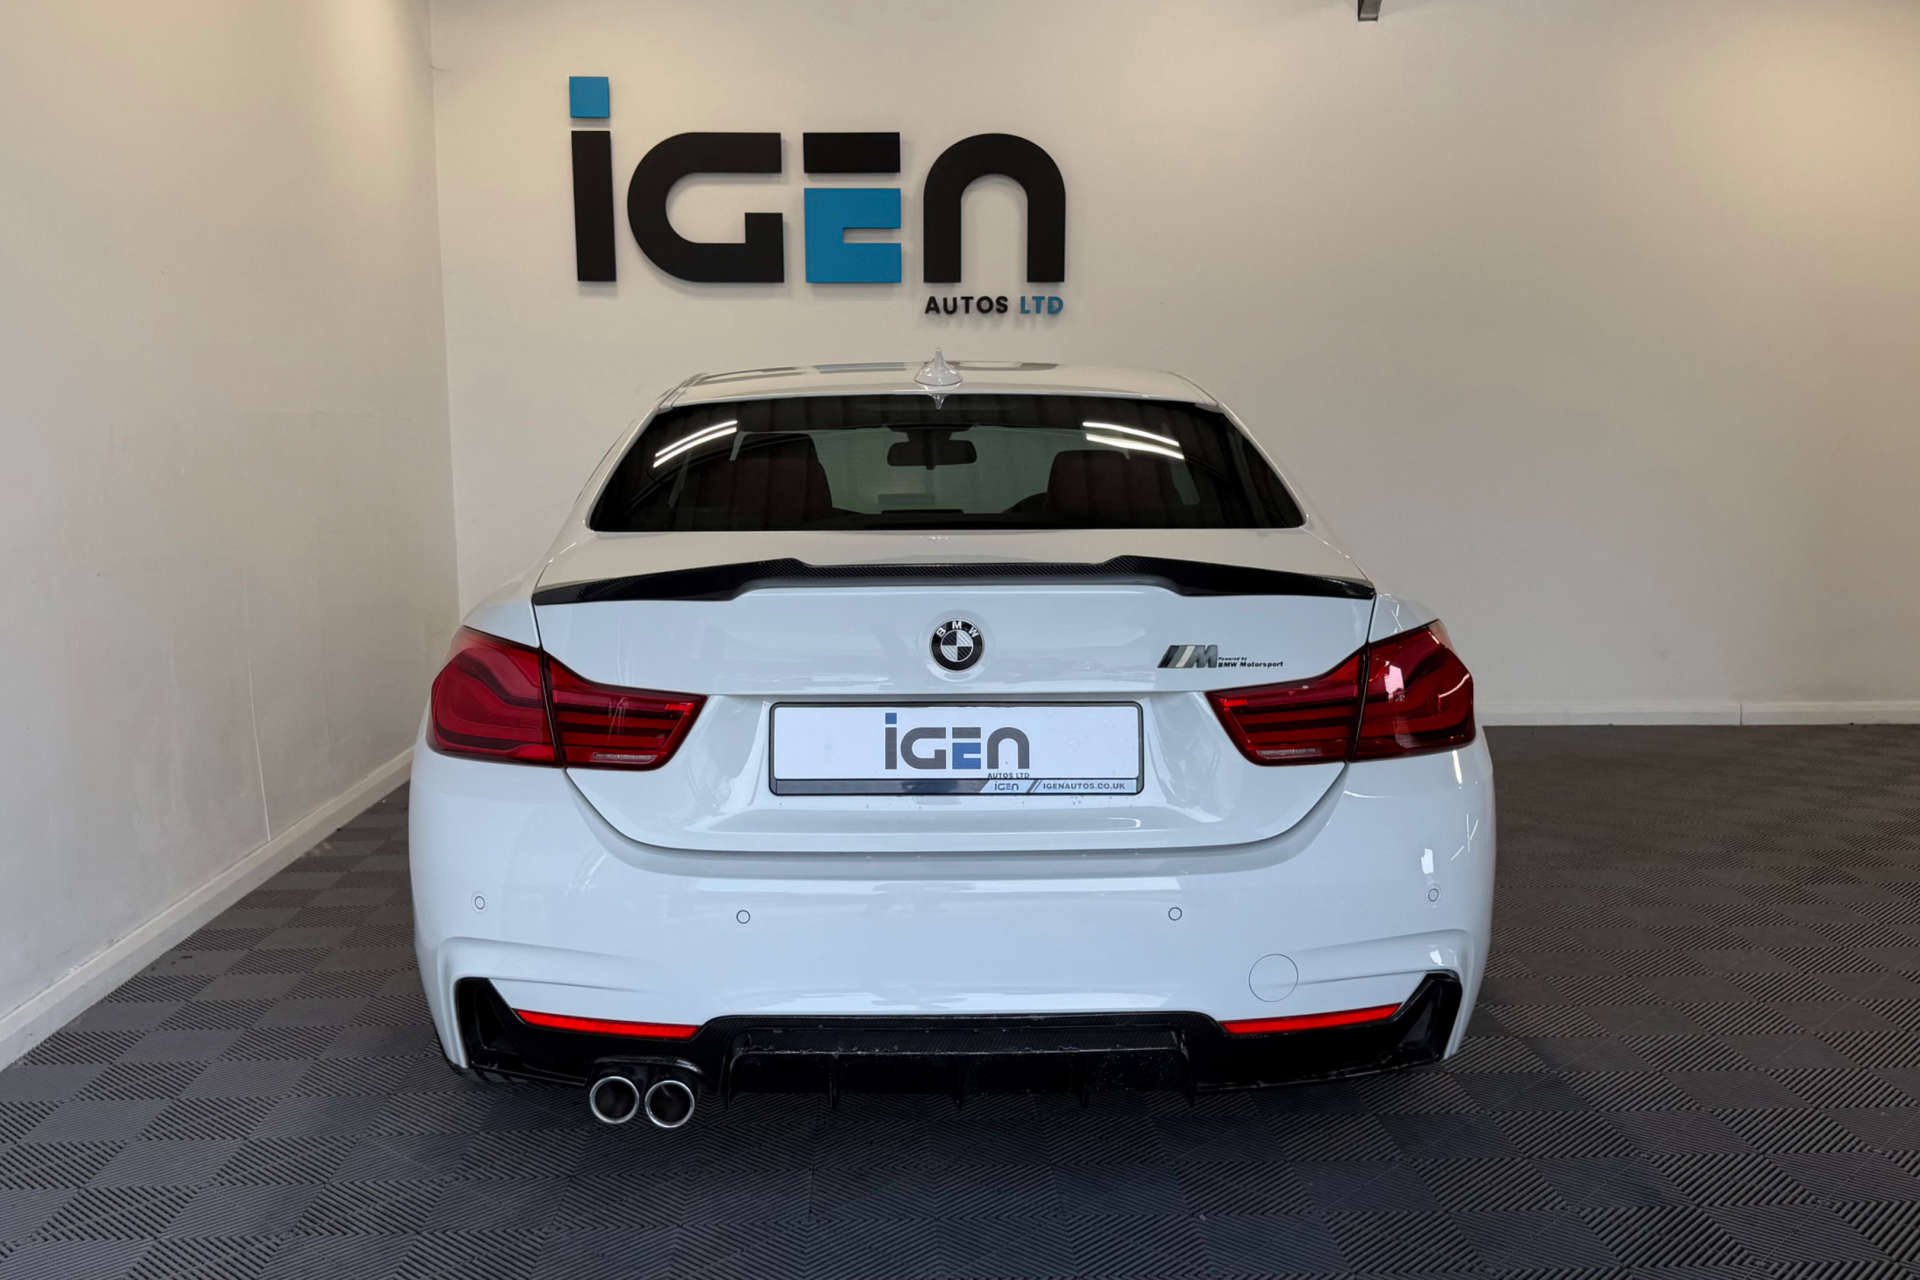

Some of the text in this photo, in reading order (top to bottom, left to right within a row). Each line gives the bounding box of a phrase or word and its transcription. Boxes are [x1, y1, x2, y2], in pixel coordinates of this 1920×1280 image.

[925, 296, 1064, 314] AUTOS LTD
[936, 621, 979, 637] BMW
